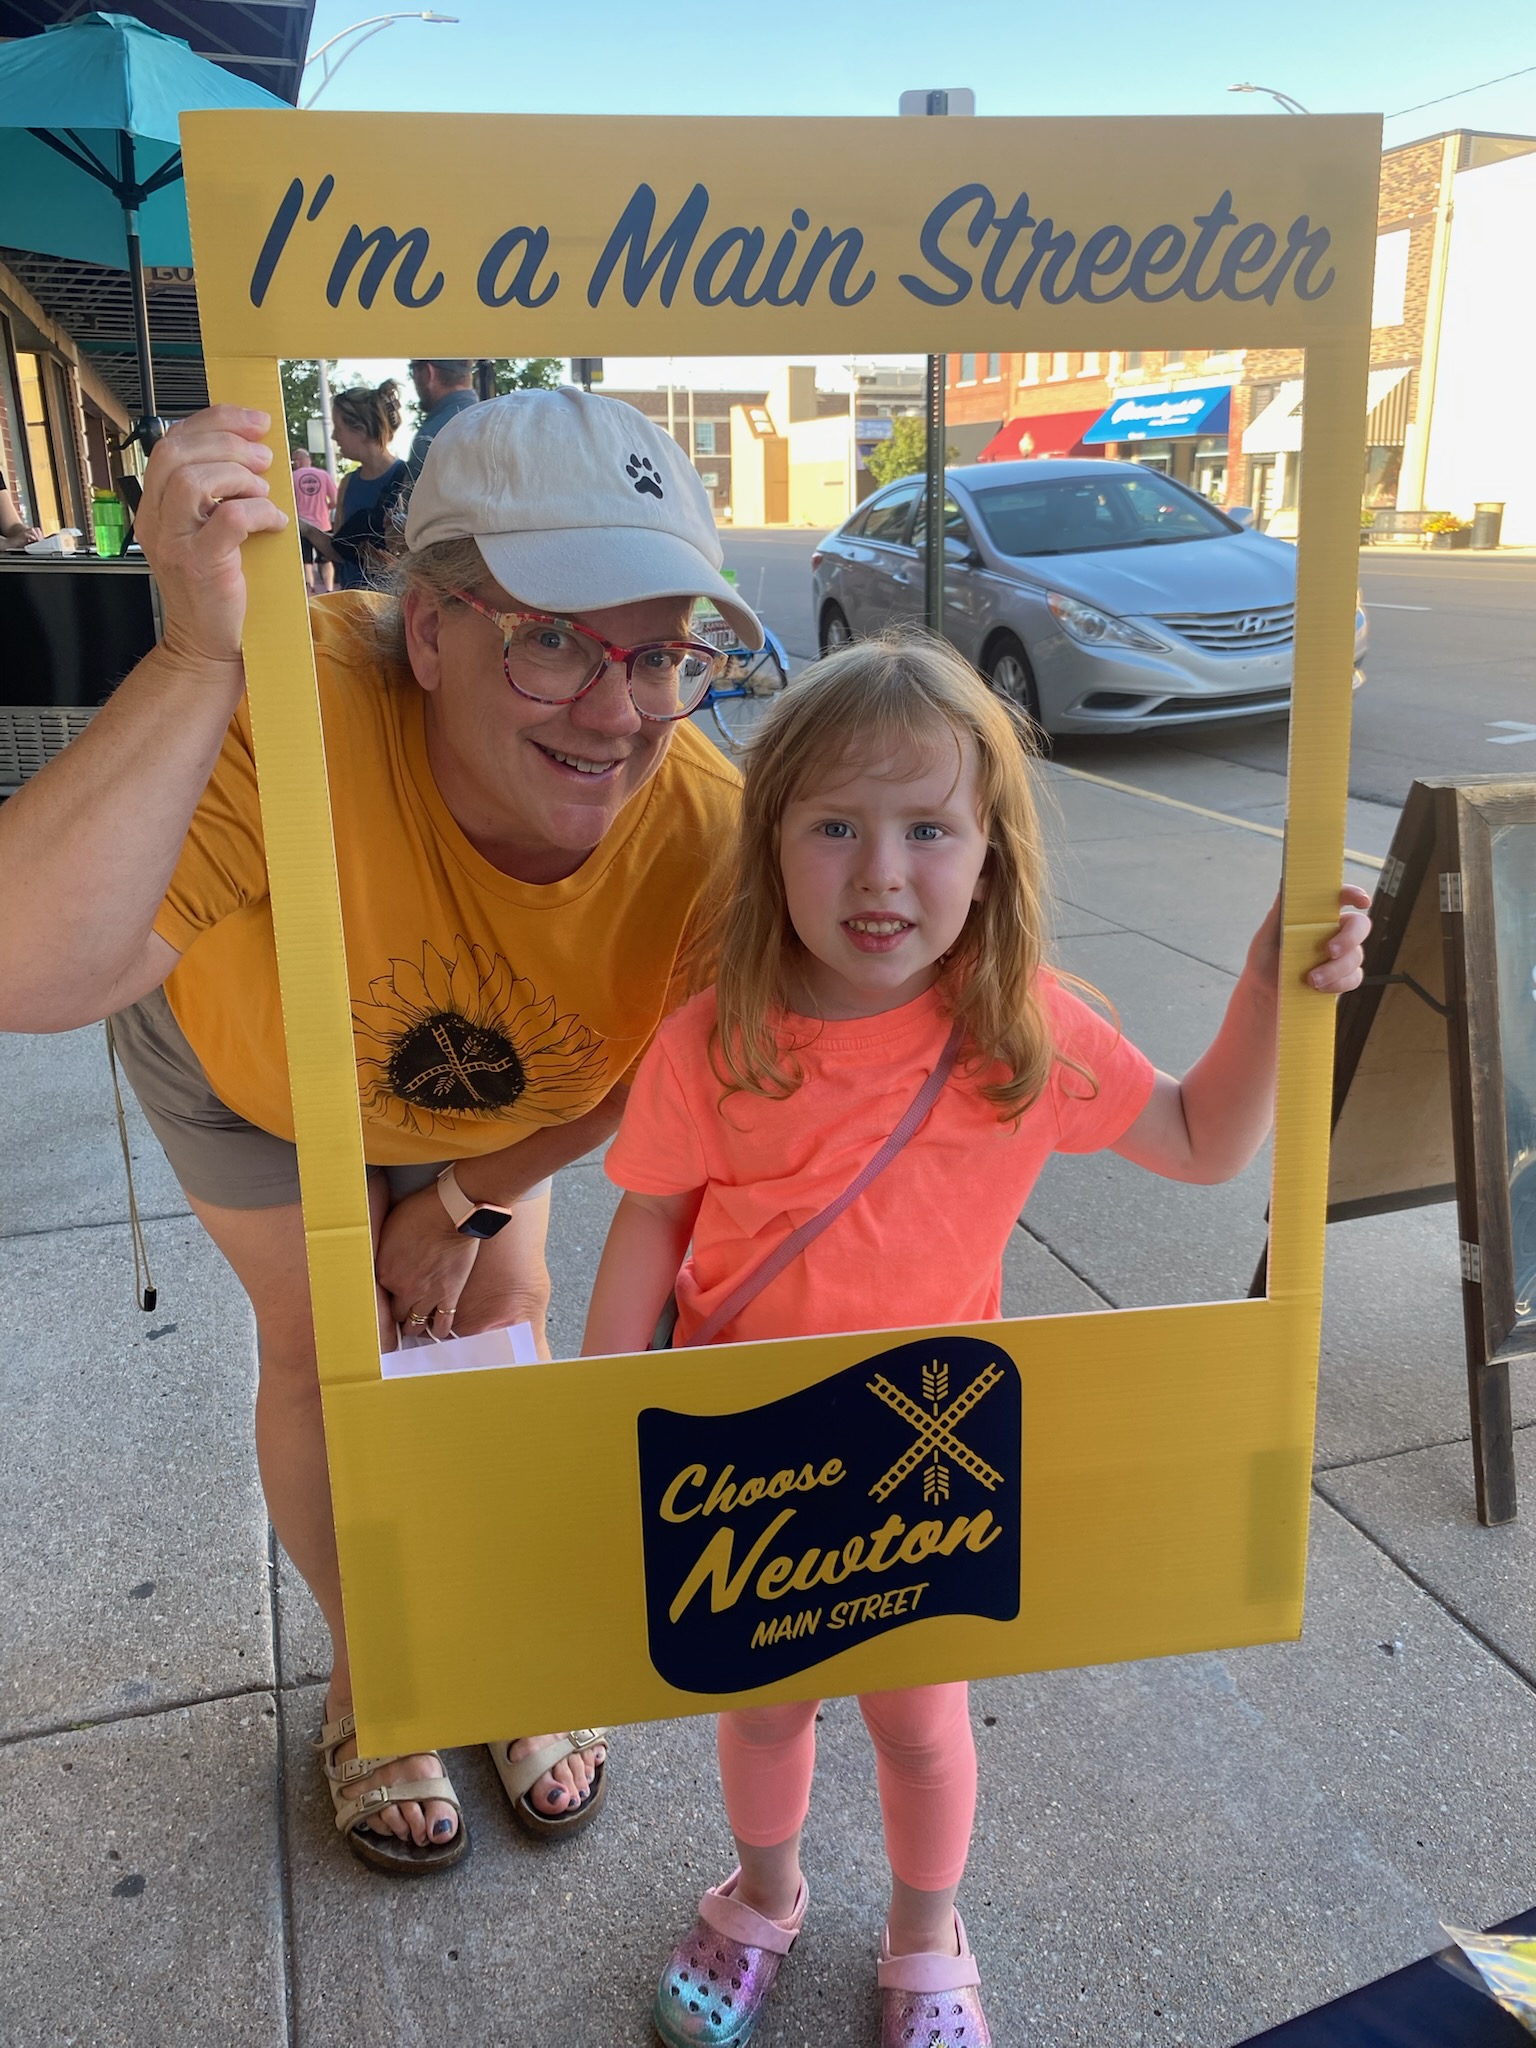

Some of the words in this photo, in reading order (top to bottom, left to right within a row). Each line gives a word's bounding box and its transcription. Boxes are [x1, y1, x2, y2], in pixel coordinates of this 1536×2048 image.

[250, 175, 444, 309] I'm
[477, 226, 560, 309] a
[587, 183, 876, 309] Main
[898, 183, 1336, 310] Streeter
[659, 1457, 847, 1523] Choose
[669, 1508, 1003, 1624] Newton
[751, 1607, 822, 1649] MAIN
[826, 1582, 930, 1630] STREET
